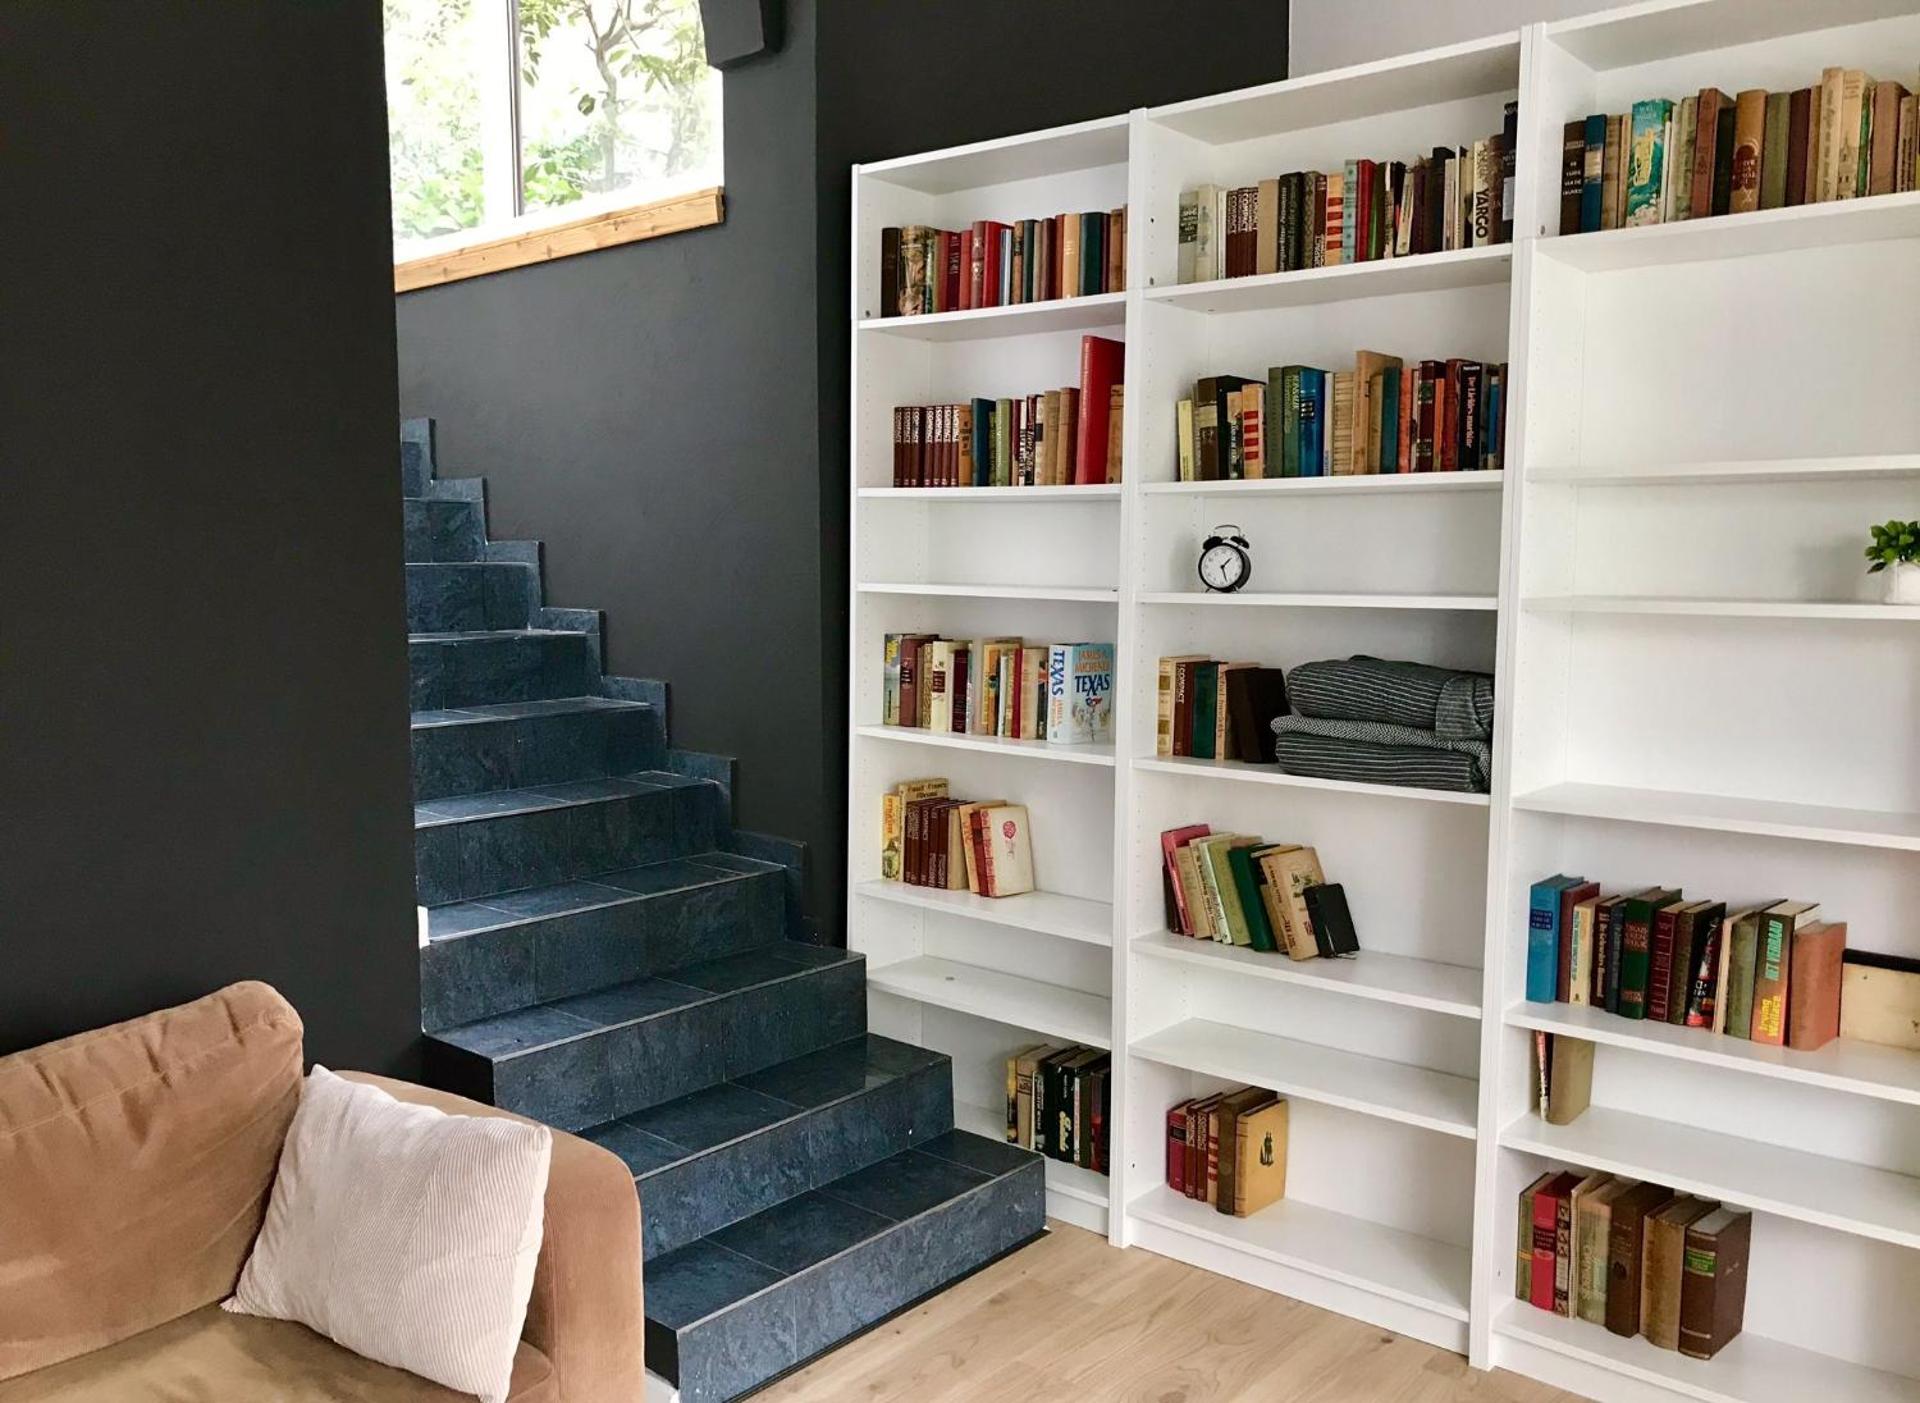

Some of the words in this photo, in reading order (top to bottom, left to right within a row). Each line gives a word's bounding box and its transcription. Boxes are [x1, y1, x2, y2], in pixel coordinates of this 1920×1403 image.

[1475, 185, 1490, 239] YARGO
[1051, 649, 1065, 696] TEXAS
[1075, 674, 1111, 696] TEXAS
